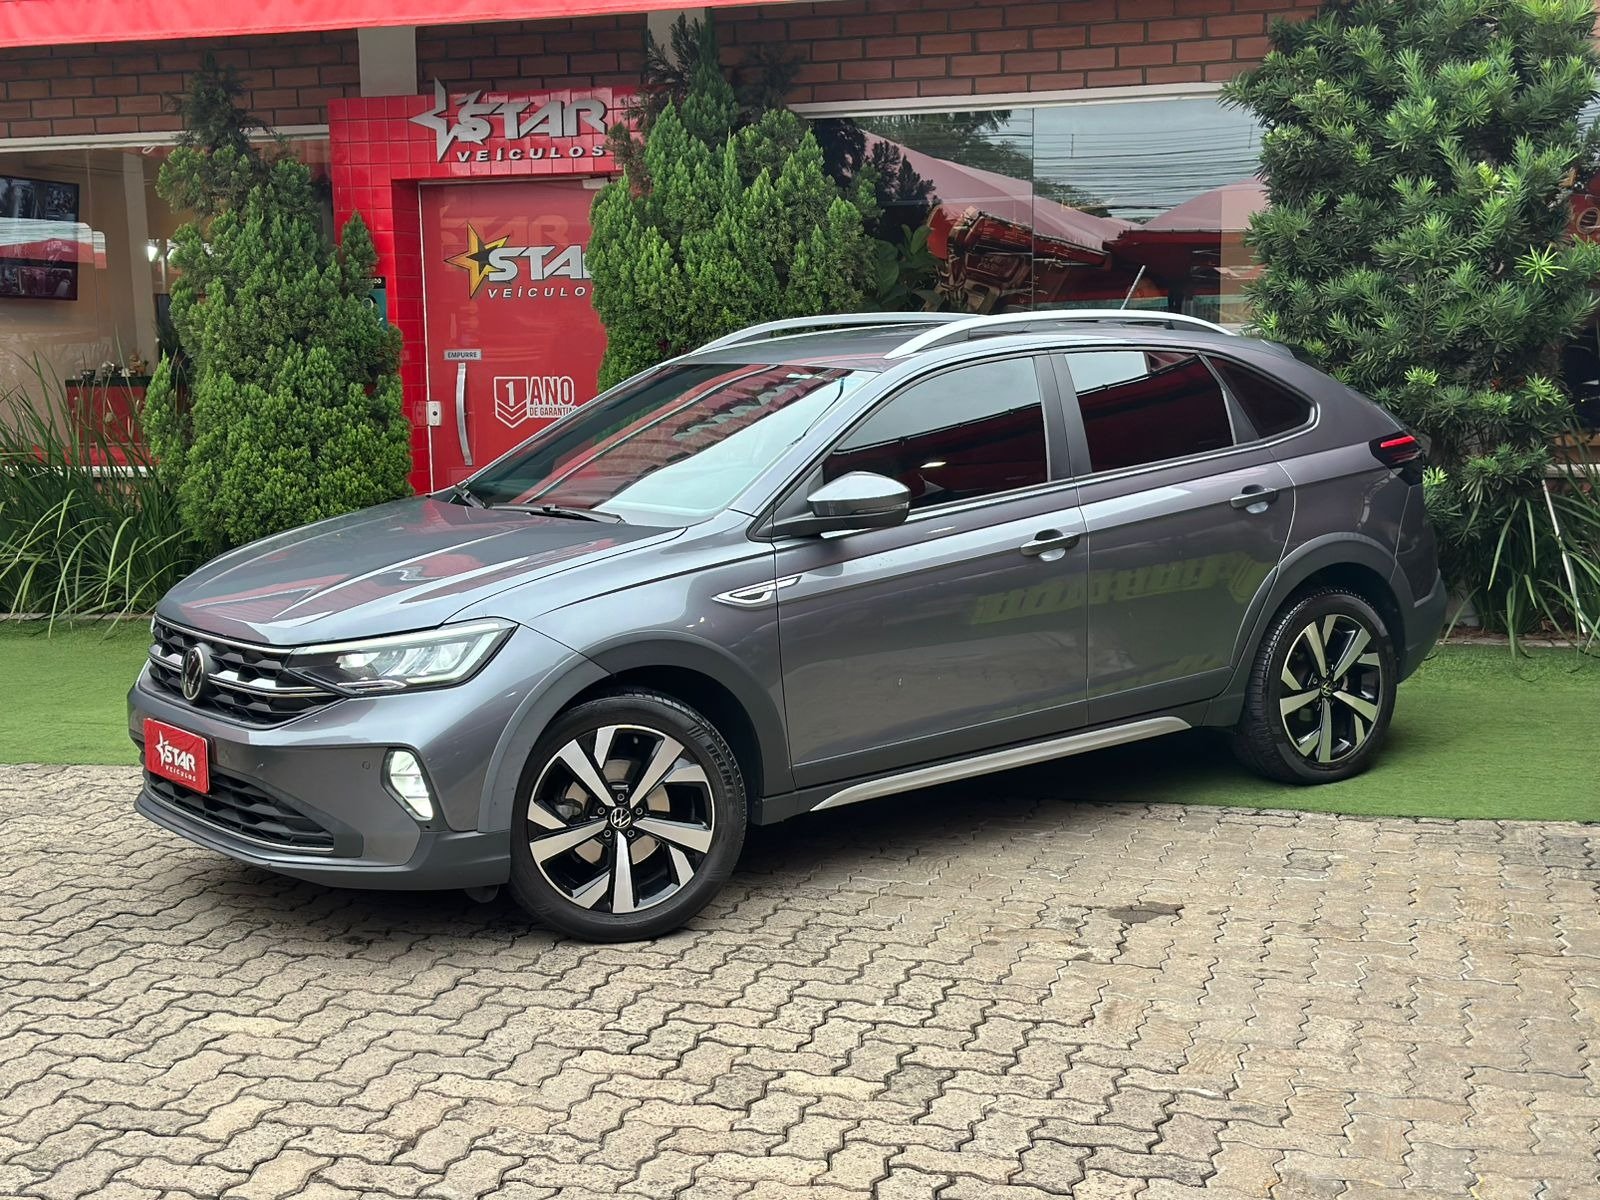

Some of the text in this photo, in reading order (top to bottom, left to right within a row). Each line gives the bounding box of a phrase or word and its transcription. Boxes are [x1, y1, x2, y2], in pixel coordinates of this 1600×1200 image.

[457, 98, 608, 144] STAR
[487, 245, 593, 282] STA
[487, 285, 595, 299] VEÍCULO
[447, 351, 478, 359] EMPURRE
[529, 376, 575, 406] ANO
[529, 407, 539, 417] DE
[164, 744, 196, 773] STAR
